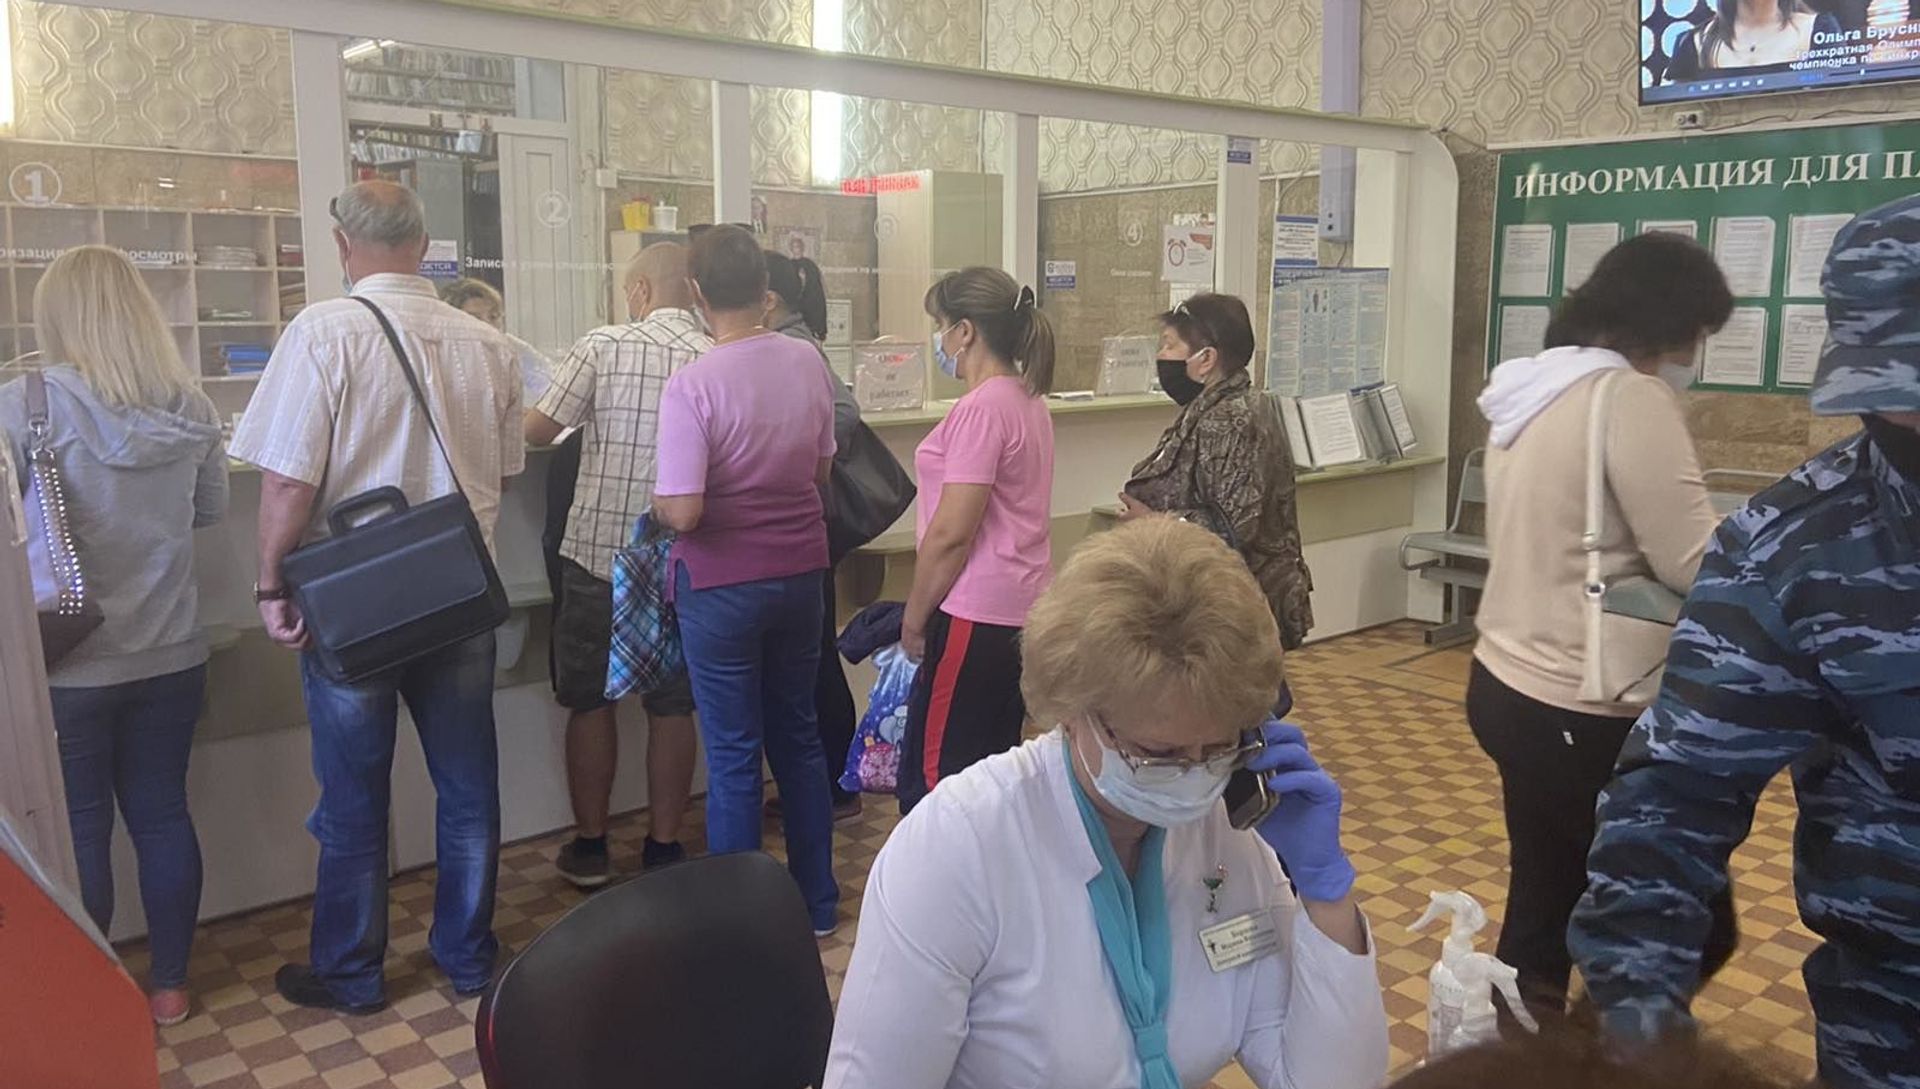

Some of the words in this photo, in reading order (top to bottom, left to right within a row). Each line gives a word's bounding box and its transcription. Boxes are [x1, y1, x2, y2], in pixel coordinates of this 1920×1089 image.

[1813, 30, 1861, 44] Ольга
[1866, 23, 1920, 39] Брусн
[25, 170, 49, 201] 1
[1513, 158, 1775, 199] ИНФОРМАЦИЯ
[1782, 153, 1872, 191] ДЛЯ
[1881, 150, 1920, 180] П
[548, 197, 564, 222] 2
[1127, 223, 1138, 241] 4
